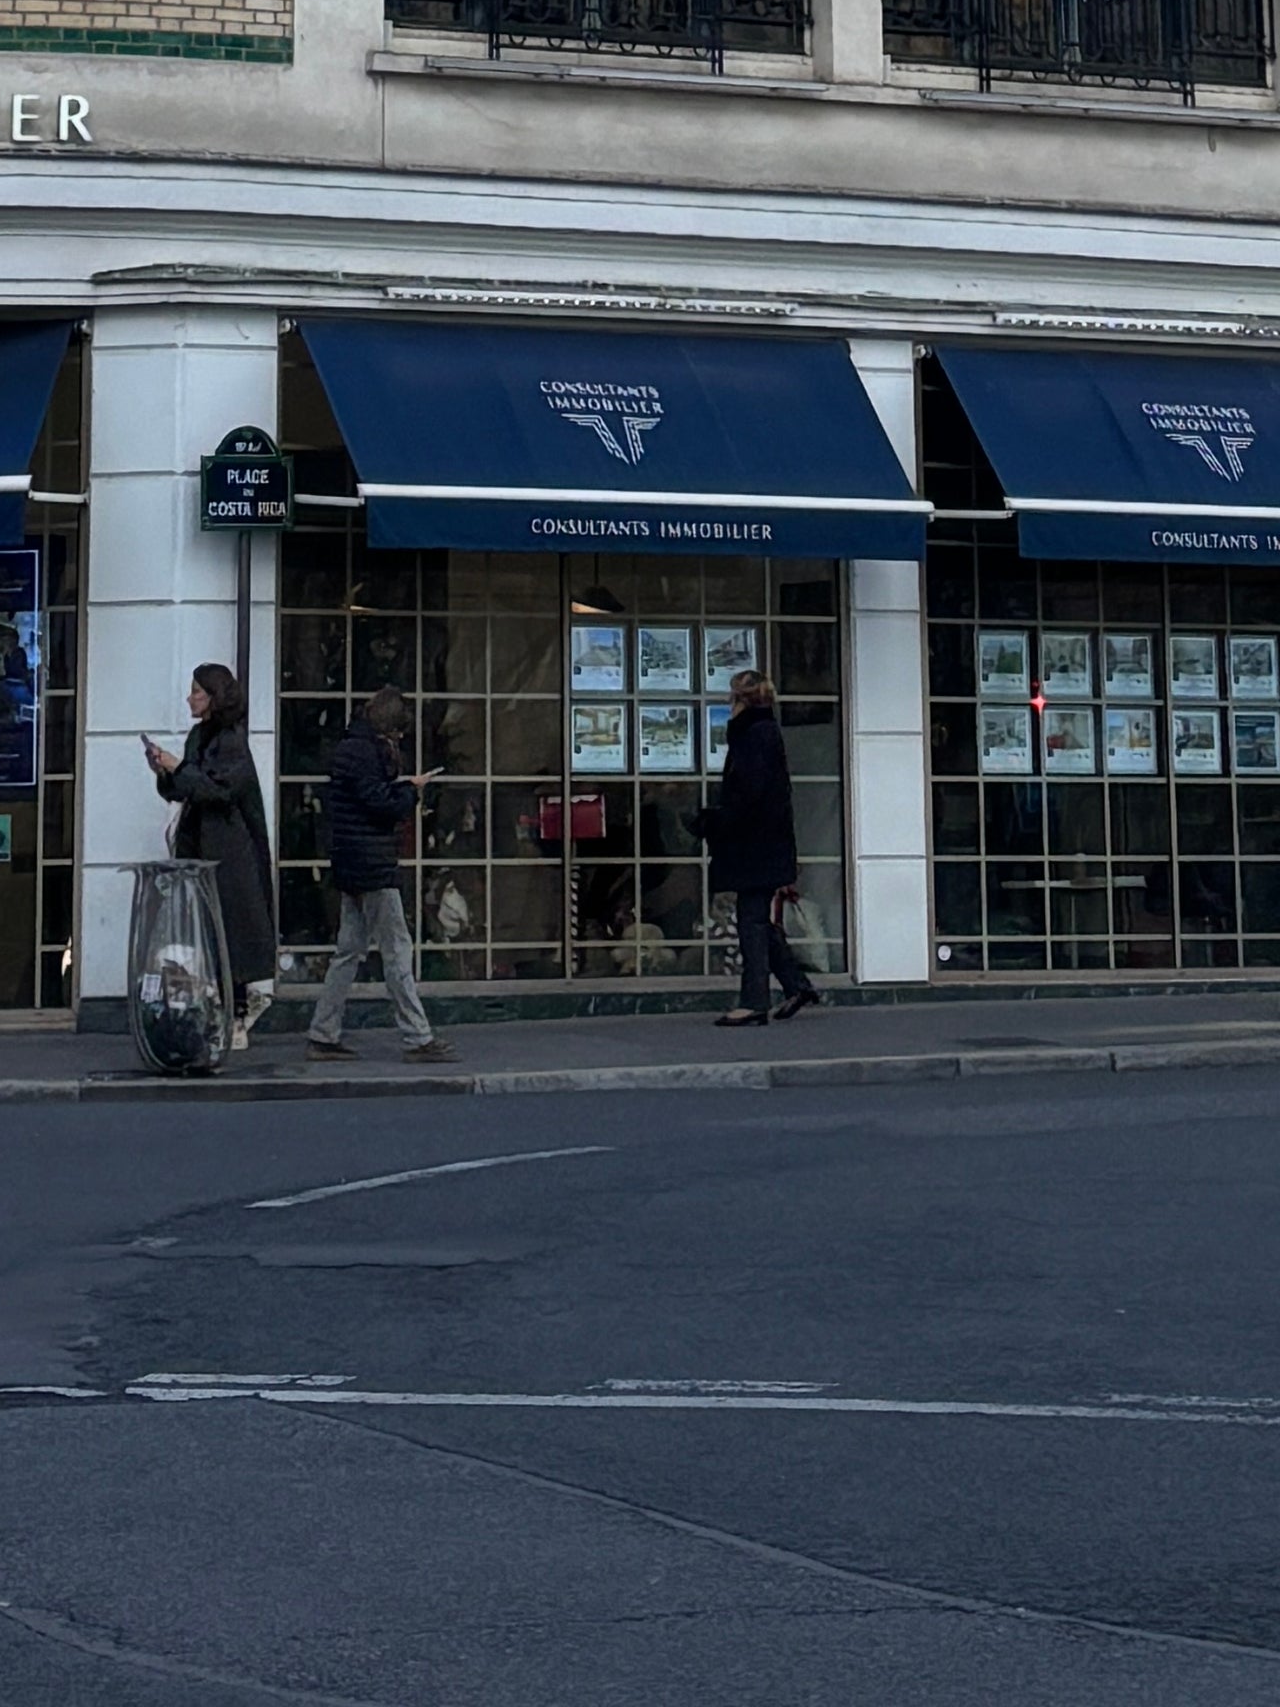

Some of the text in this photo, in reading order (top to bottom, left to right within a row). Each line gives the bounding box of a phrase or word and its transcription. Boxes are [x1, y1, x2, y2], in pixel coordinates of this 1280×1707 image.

[540, 381, 659, 399] CONSULTANTS
[547, 396, 664, 414] IMMOBILIER
[1142, 403, 1250, 420] CONSULTANTS
[1150, 417, 1256, 435] IMMOBILIER
[227, 469, 269, 484] PLACE
[208, 501, 252, 516] COSTA
[531, 518, 772, 540] CONSULTANTS IMMOBILIER
[1152, 531, 1258, 550] CONSULTANTS
